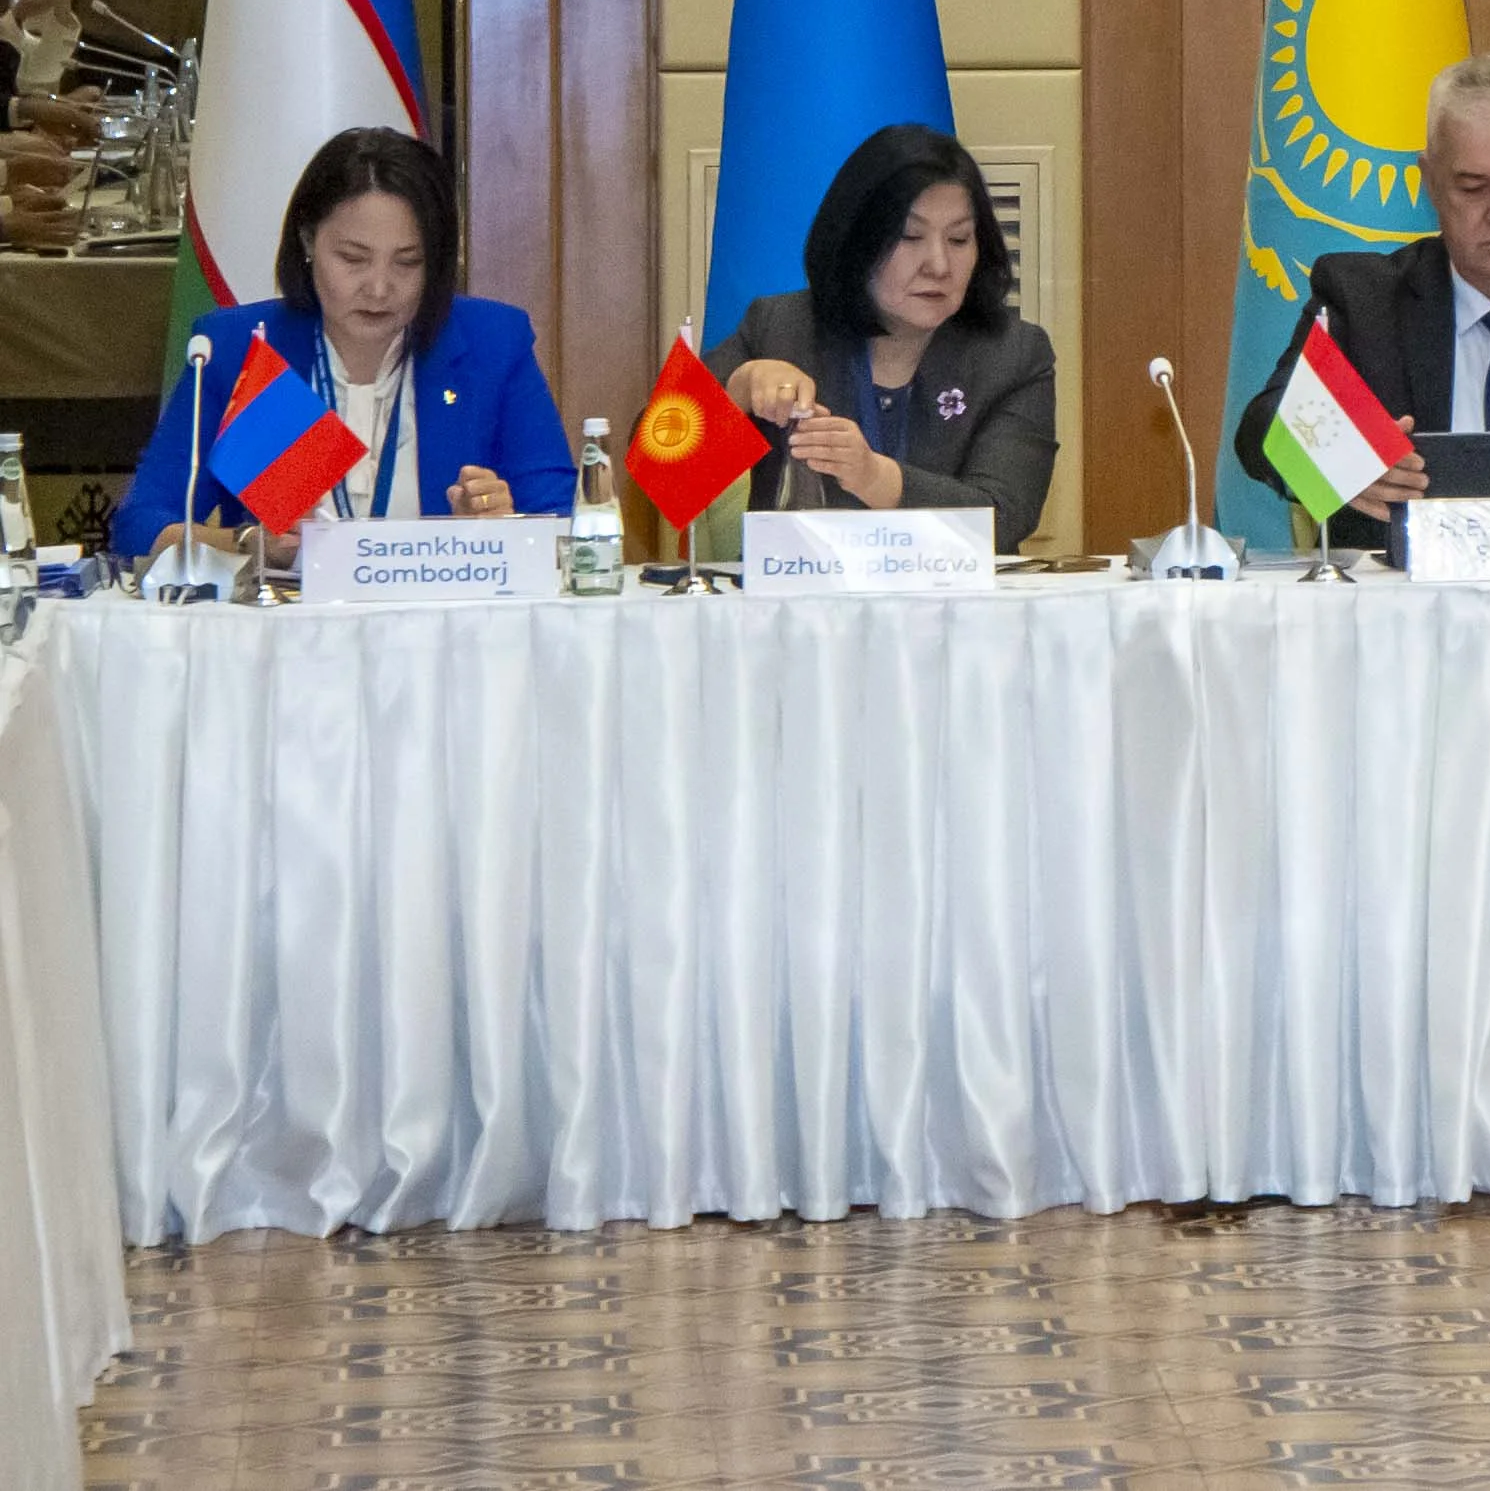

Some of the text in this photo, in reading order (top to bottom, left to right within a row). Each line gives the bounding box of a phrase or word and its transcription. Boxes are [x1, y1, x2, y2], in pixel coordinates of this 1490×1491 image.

[357, 536, 503, 557] Sarankhuu
[353, 561, 508, 585] Gombodorj
[763, 553, 978, 577] Dzhuspbekova
